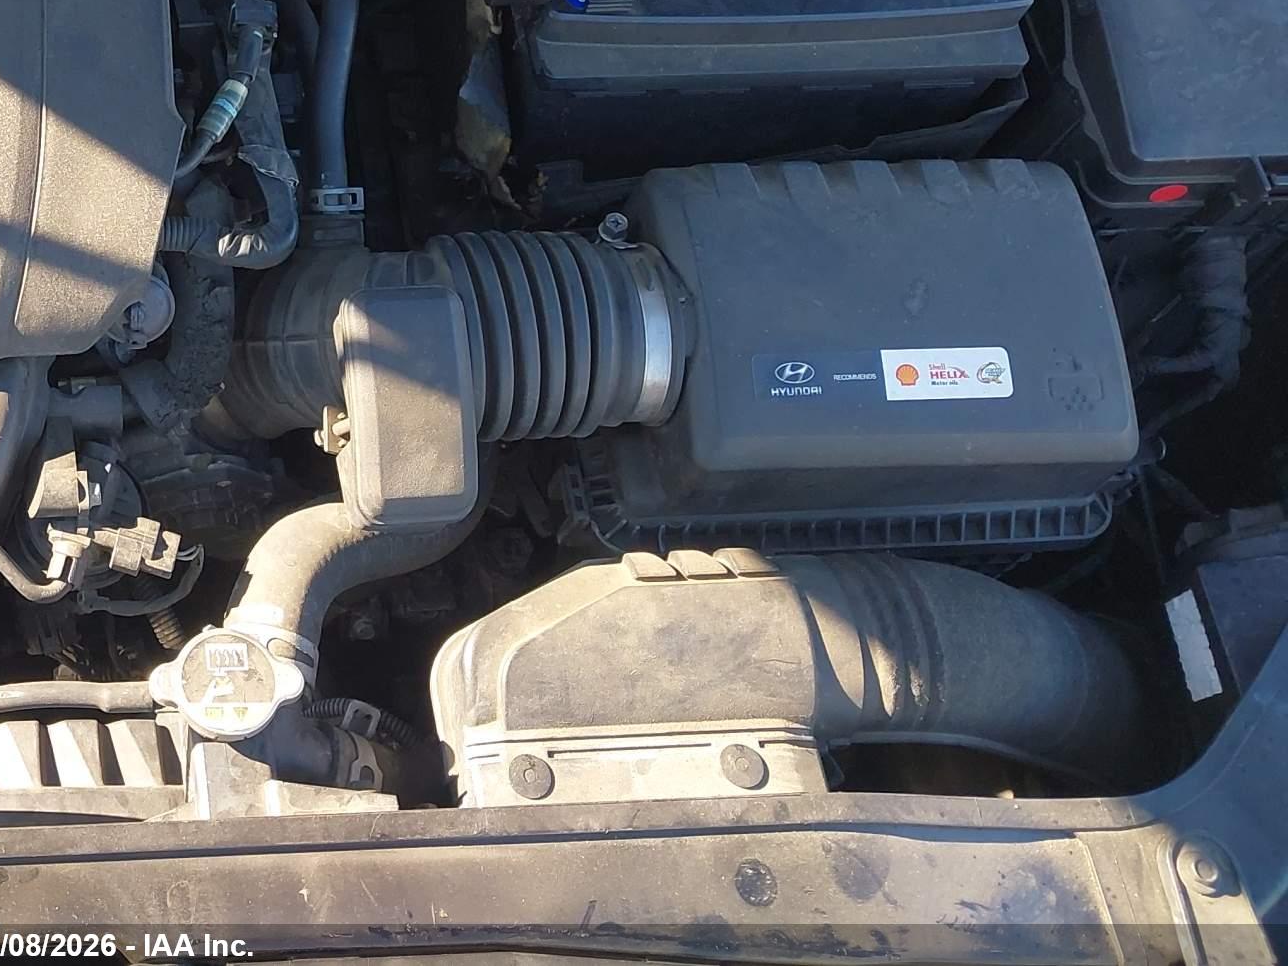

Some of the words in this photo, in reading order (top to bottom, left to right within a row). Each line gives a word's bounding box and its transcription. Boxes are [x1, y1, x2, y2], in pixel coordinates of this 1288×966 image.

[833, 372, 877, 381] RECOMMENDS
[930, 370, 968, 379] HELIX
[770, 387, 823, 397] HYUNDAI
